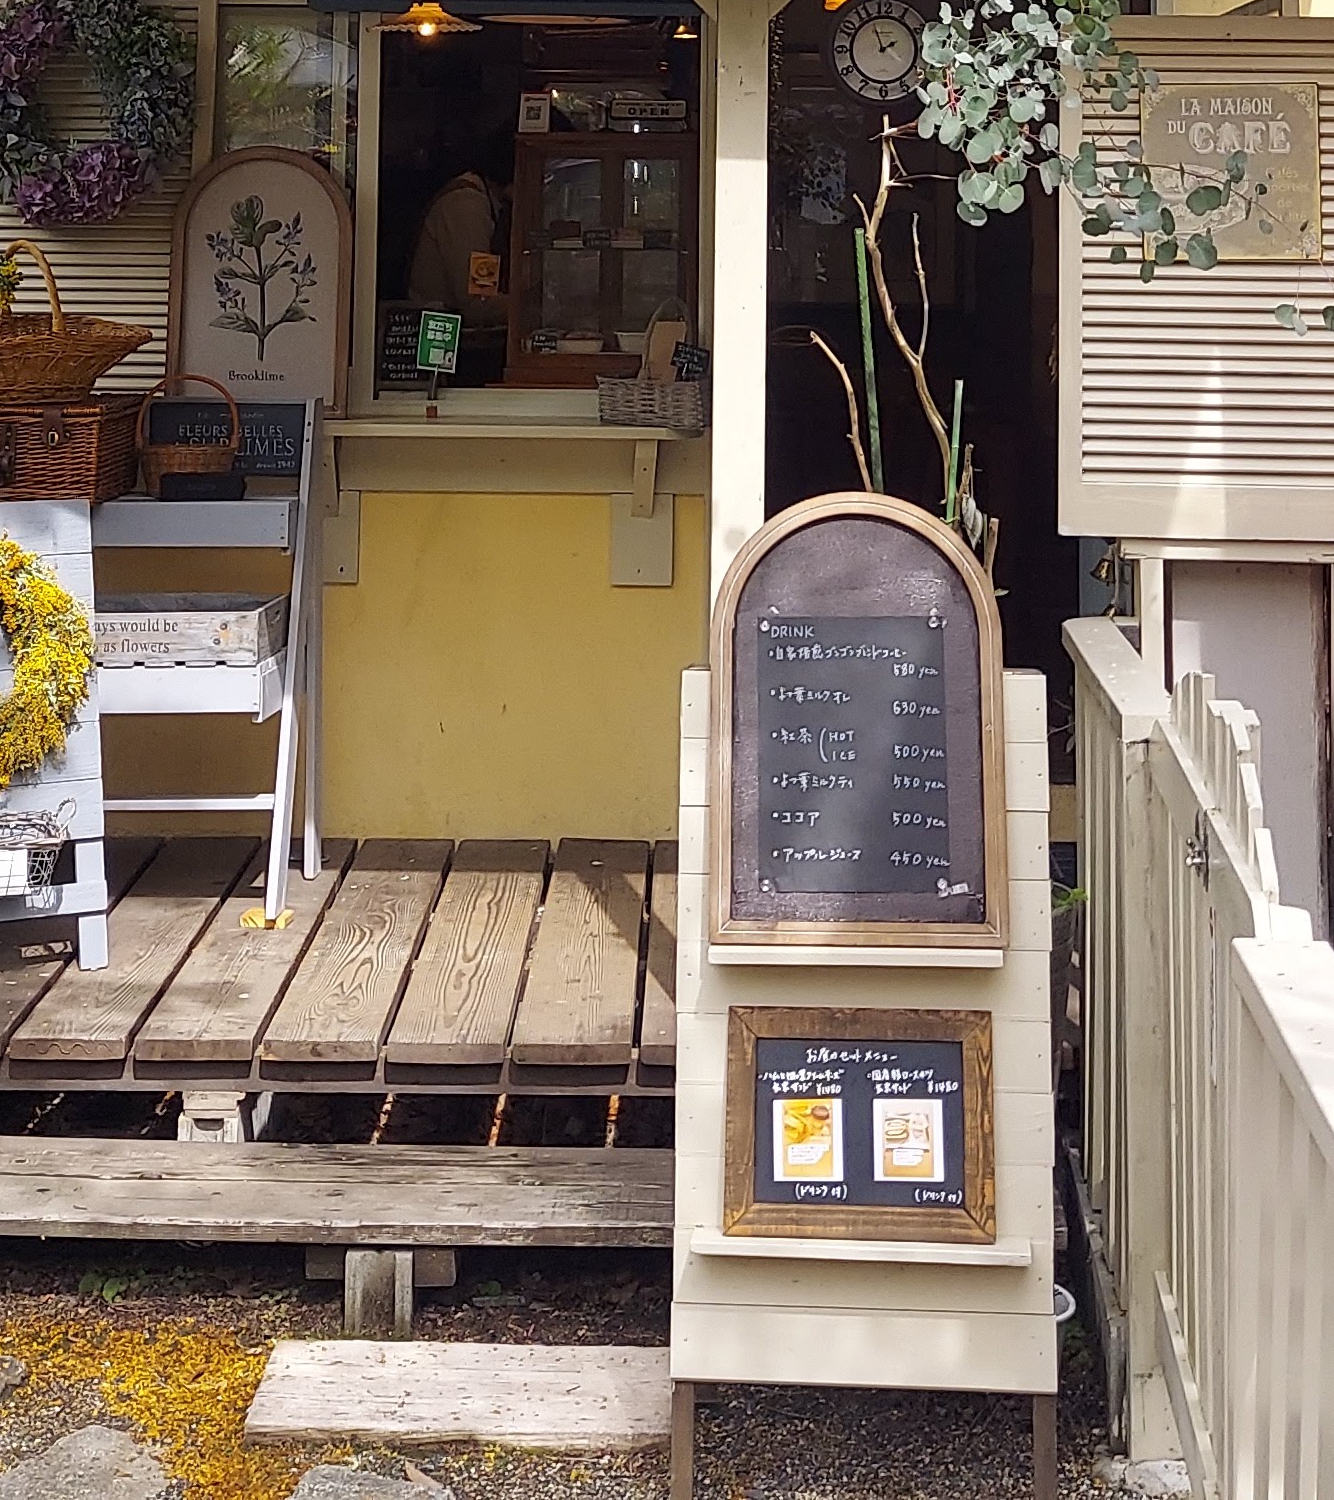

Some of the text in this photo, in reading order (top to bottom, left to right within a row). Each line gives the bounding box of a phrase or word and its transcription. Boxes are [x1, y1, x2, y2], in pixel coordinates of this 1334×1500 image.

[856, 3, 873, 22] 11
[876, 1, 893, 15] 12
[898, 7, 909, 19] 1
[840, 19, 856, 37] 10
[835, 44, 849, 54] 9
[840, 65, 854, 76] 8
[858, 79, 869, 94] 7
[879, 85, 889, 98] 6
[899, 79, 910, 93] 5
[628, 107, 670, 116] OPEN
[1180, 97, 1273, 116] LA MAISON
[1168, 112, 1292, 155] DU CAFÉ
[228, 370, 284, 381] Brooklime
[179, 424, 227, 437] FLEURS
[94, 618, 178, 635] ays would be
[771, 626, 815, 638] DRINK
[103, 638, 170, 653] as flowers
[893, 663, 938, 679] 580 yen
[893, 701, 941, 718] 630 yen
[781, 727, 855, 744] 紅茶 HOT
[832, 750, 856, 761] ICE
[894, 744, 945, 762] 500 yen
[893, 774, 946, 792] 550 yen
[781, 811, 820, 827] ココア
[892, 812, 947, 829] 500 yen
[889, 851, 950, 869] 450 yen
